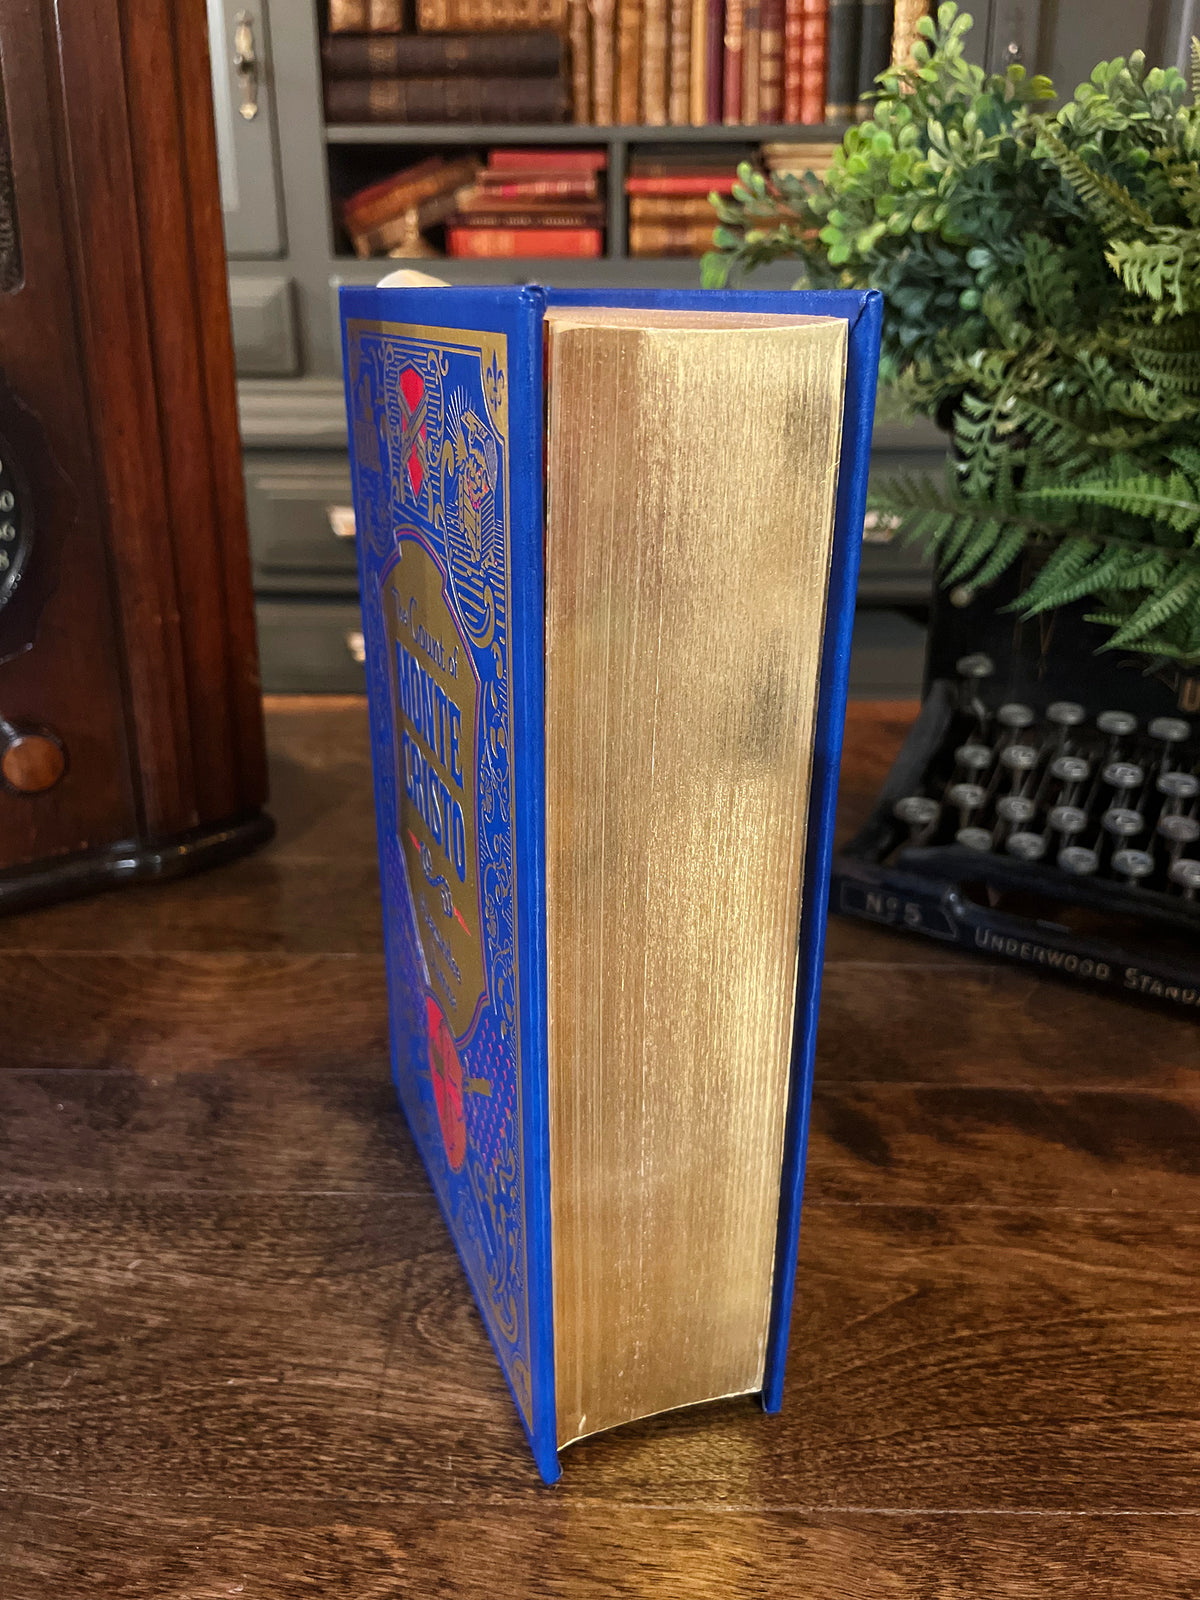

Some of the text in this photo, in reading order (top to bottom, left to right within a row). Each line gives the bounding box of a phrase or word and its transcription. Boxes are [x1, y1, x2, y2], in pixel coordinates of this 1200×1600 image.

[409, 596, 445, 672] Count
[448, 645, 459, 680] of
[395, 638, 465, 791] MONTE
[402, 729, 467, 884] CRISTO
[975, 926, 1111, 982] UNDERWOOD
